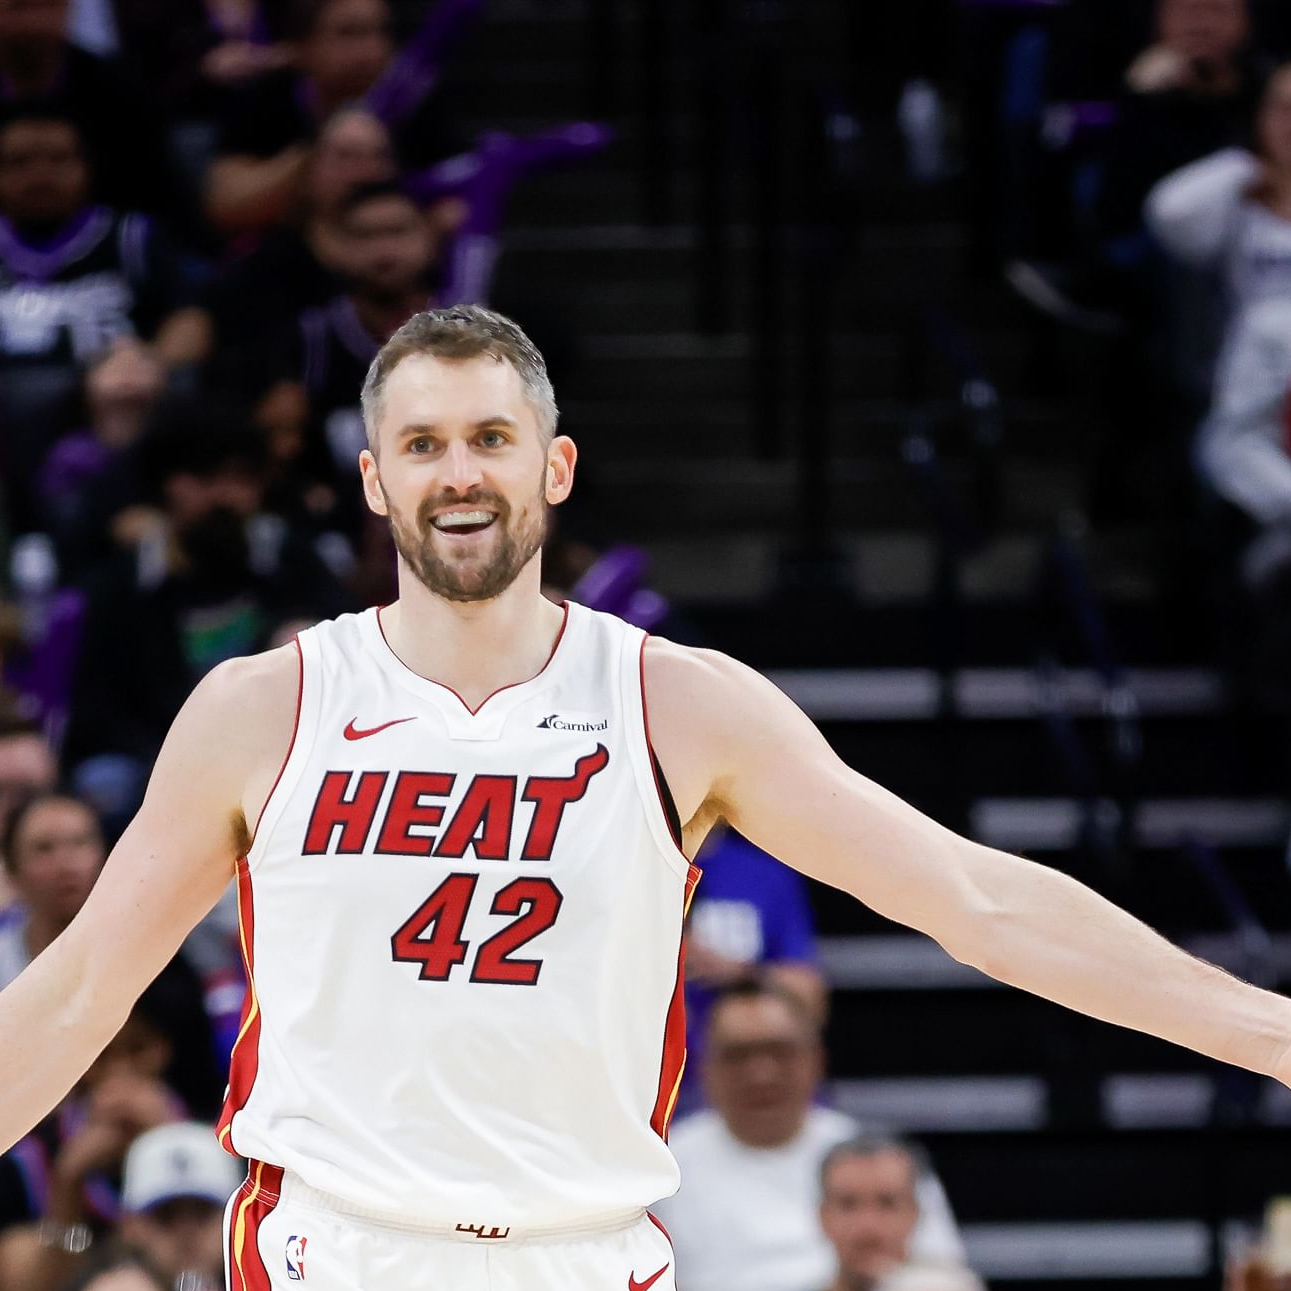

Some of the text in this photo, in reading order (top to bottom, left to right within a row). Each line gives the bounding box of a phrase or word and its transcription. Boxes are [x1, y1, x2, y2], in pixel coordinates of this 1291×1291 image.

[553, 720, 608, 732] Carnival
[301, 742, 610, 861] HEAT
[391, 872, 564, 986] 42
